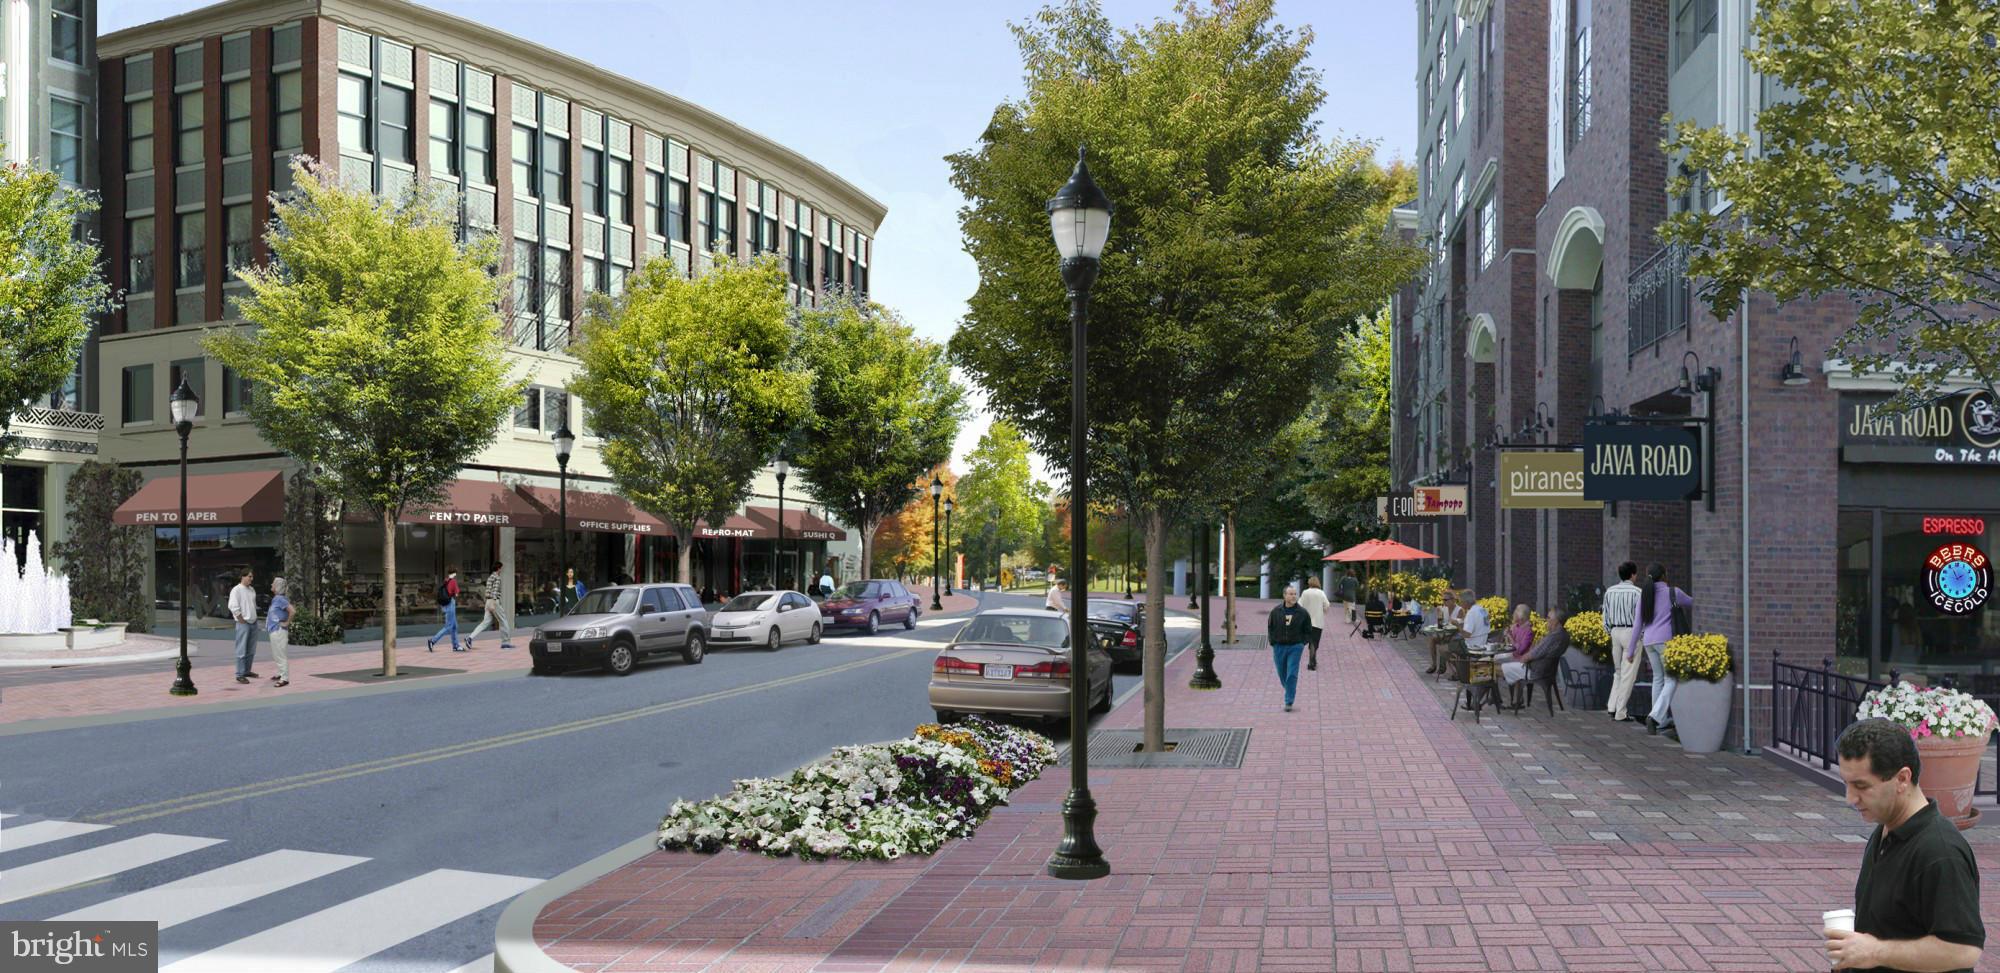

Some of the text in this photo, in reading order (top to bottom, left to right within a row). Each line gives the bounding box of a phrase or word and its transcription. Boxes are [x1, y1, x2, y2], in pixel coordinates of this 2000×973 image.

[1850, 404, 1953, 437] JAVA ROAD
[1591, 444, 1692, 477] JAVA ROAD
[1935, 448, 1953, 461] On
[1960, 449, 1981, 462] The
[136, 511, 217, 522] PEN TO APER
[454, 513, 471, 522] TO
[473, 513, 510, 524] PAPER
[580, 520, 651, 532] OFFICE SUPPLIES
[702, 528, 755, 537] REPRO-MAT
[1923, 517, 1985, 535] ESPRESSO
[803, 531, 828, 539] SUSHI
[1929, 545, 1985, 568] BEERS
